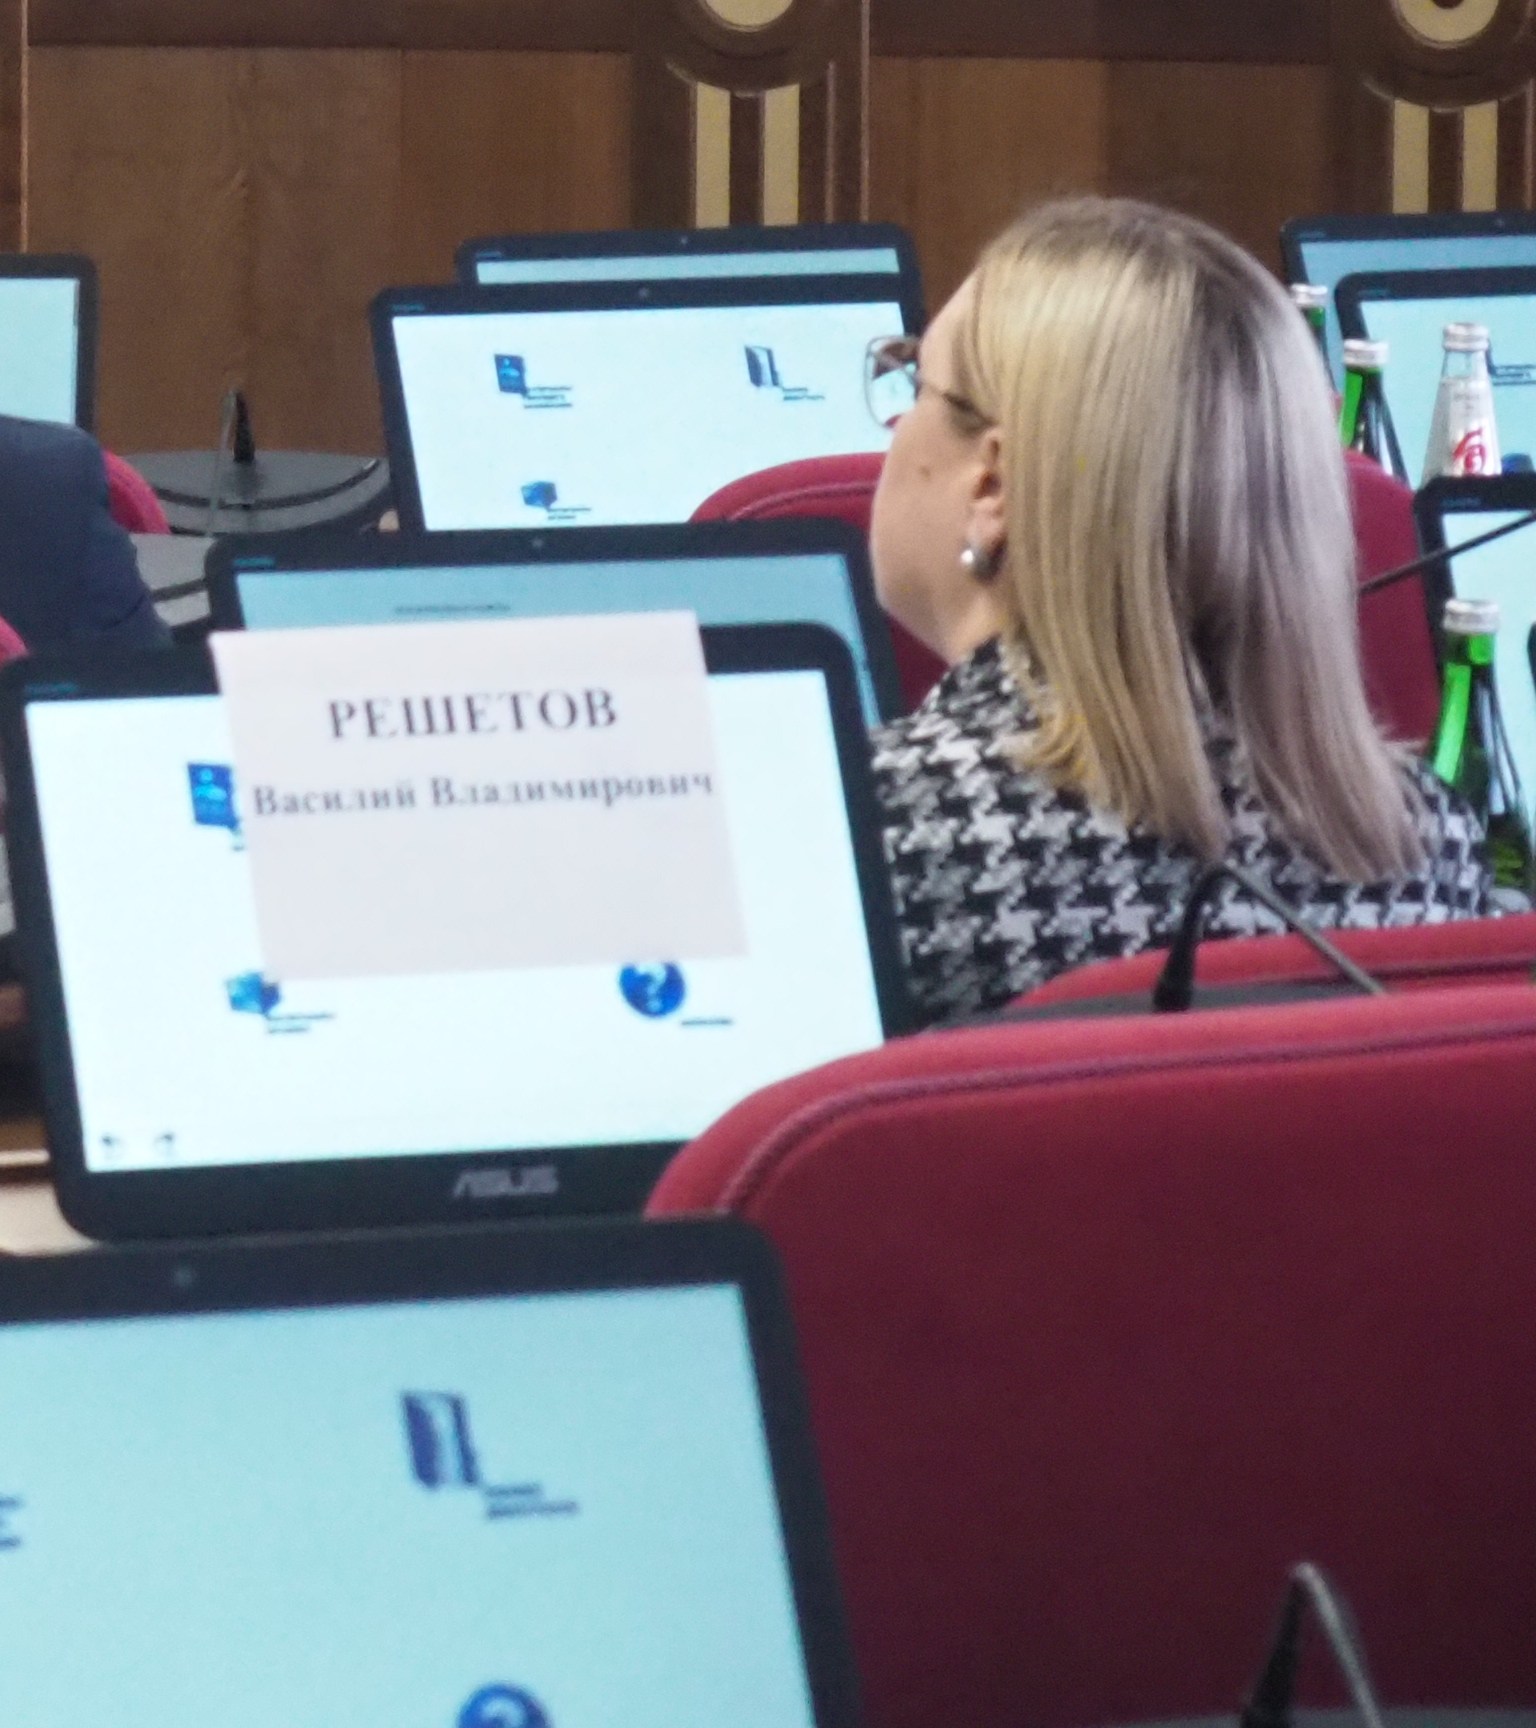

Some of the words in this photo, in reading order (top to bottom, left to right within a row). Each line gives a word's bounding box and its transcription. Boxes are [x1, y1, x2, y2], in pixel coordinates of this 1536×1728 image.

[328, 688, 618, 740] РЕШЕТОВ
[252, 777, 418, 818] Василий
[429, 770, 715, 811] Владимирович
